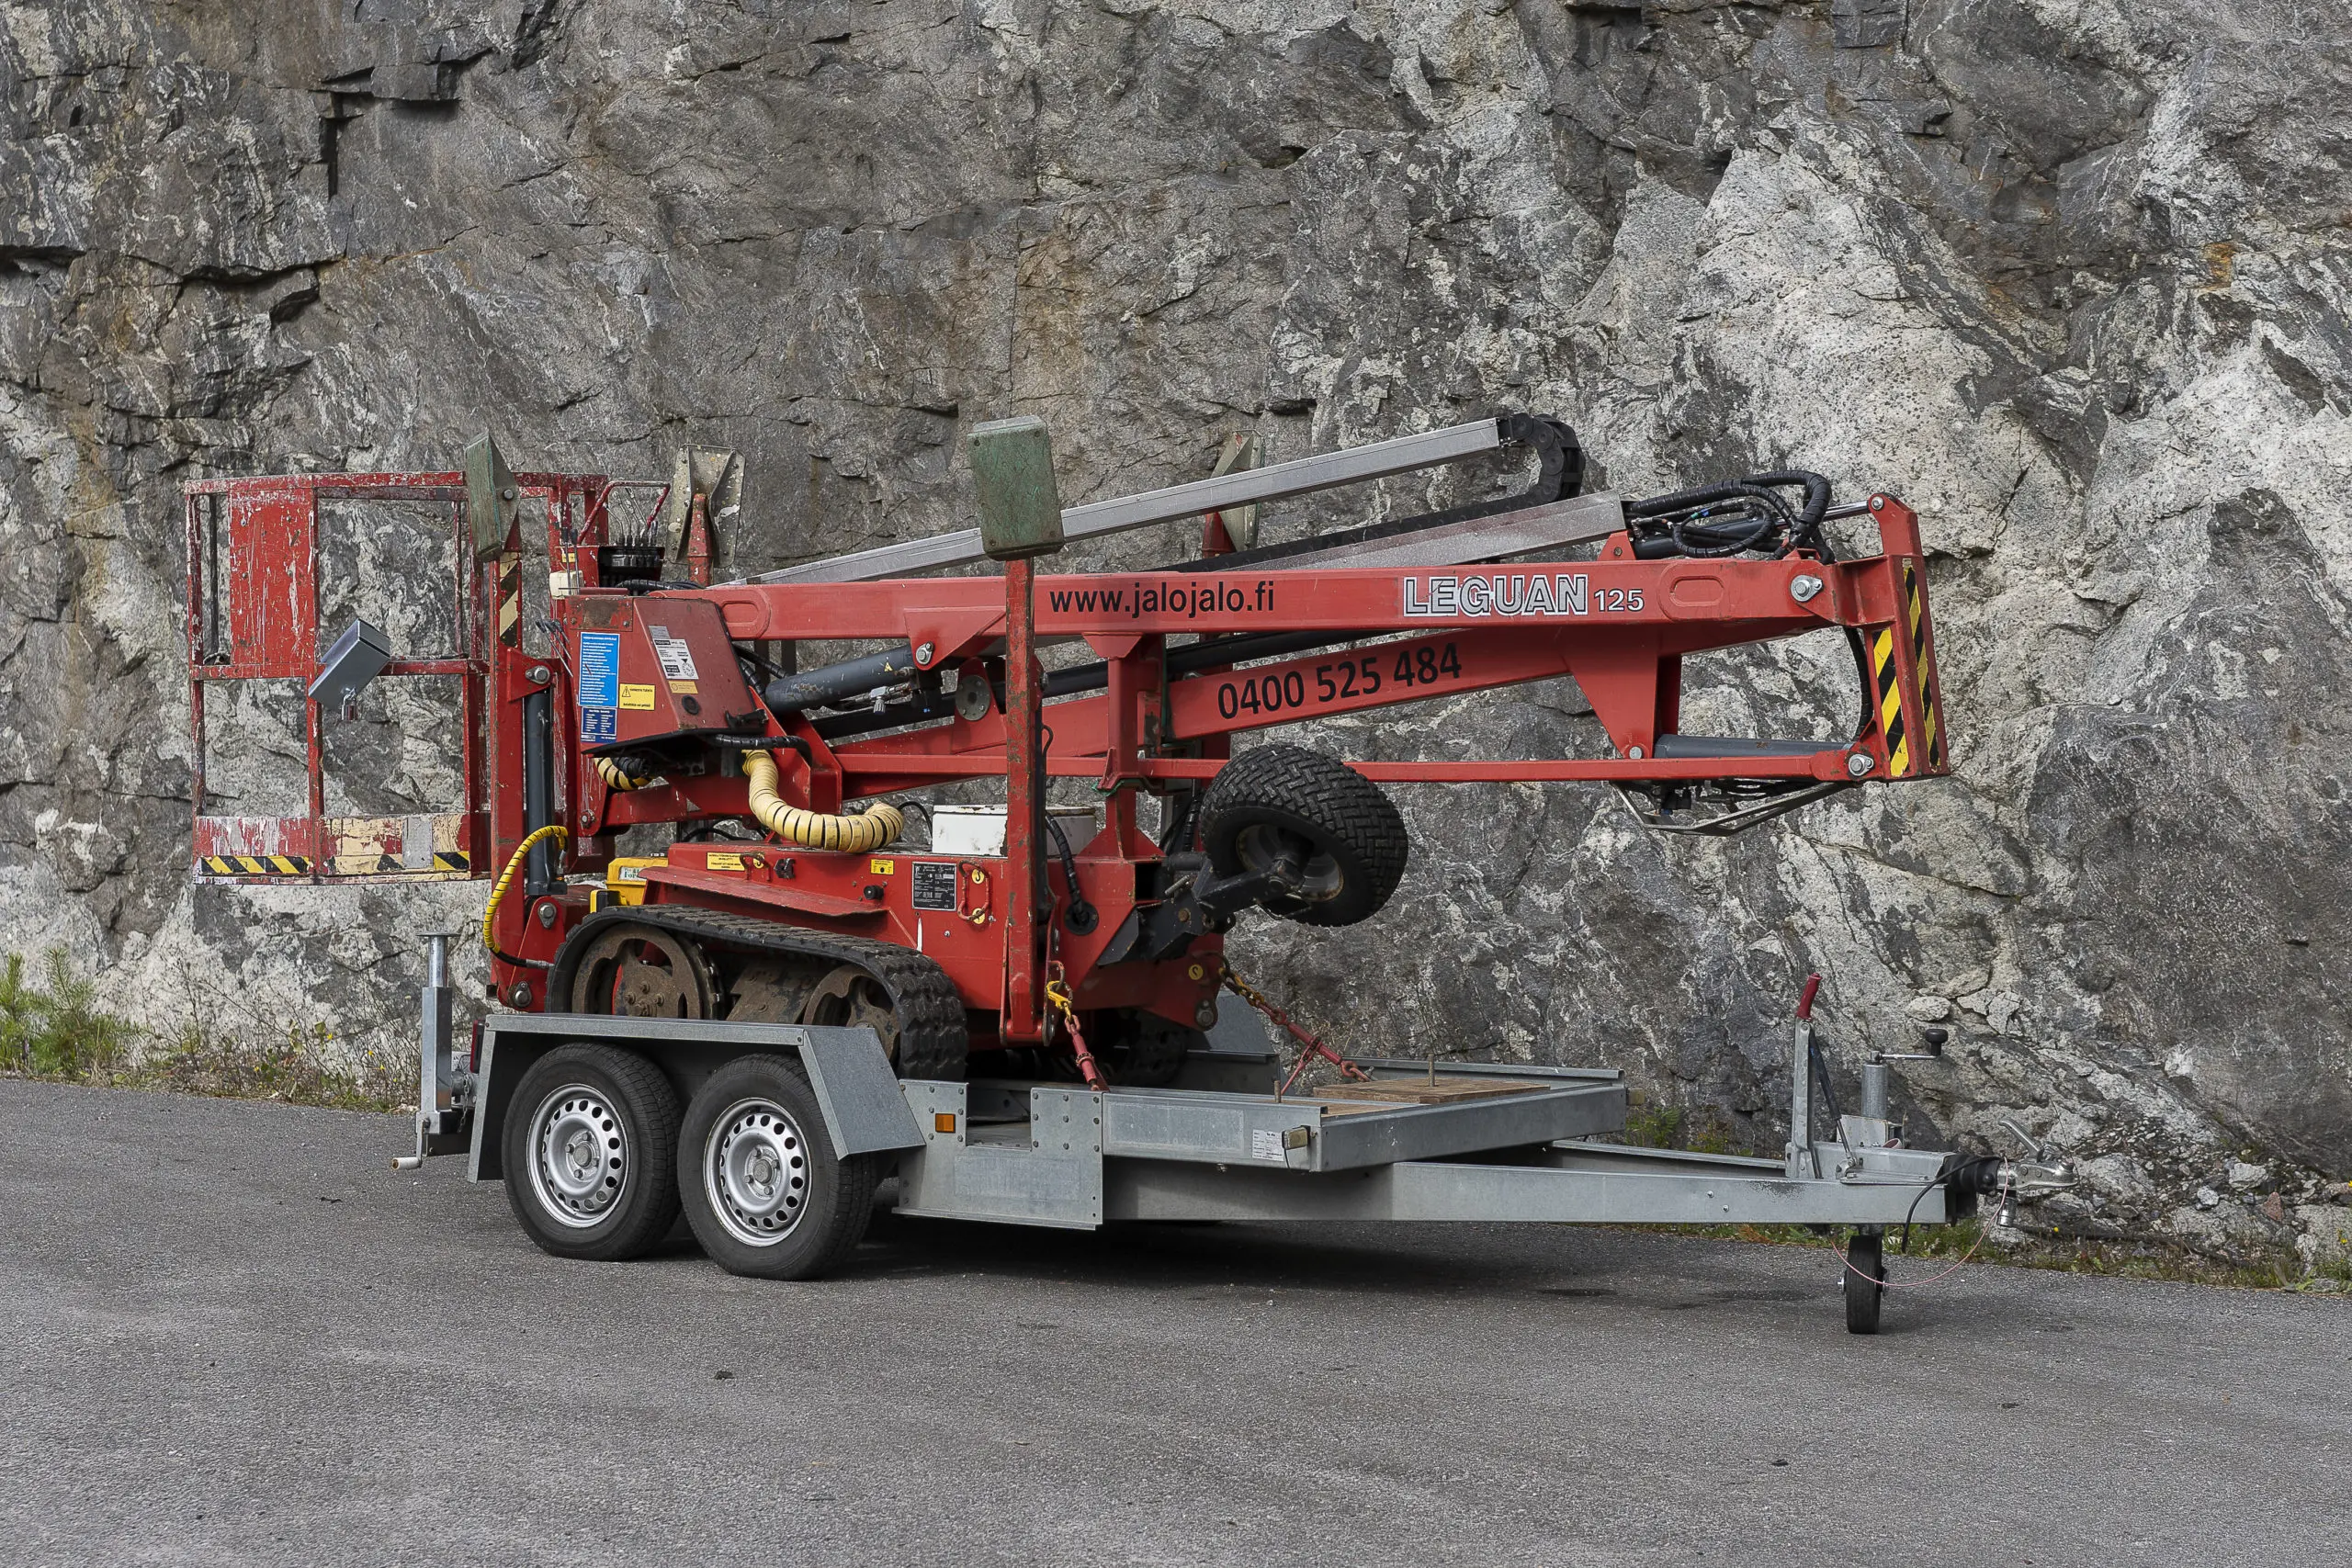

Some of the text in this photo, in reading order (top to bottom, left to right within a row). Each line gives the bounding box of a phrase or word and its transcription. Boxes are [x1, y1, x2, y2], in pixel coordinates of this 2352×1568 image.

[1049, 581, 1274, 619] www.jalojalo.fi
[1403, 573, 1645, 617] LEGUAN 125
[1217, 642, 1462, 720] 0400 525 484
